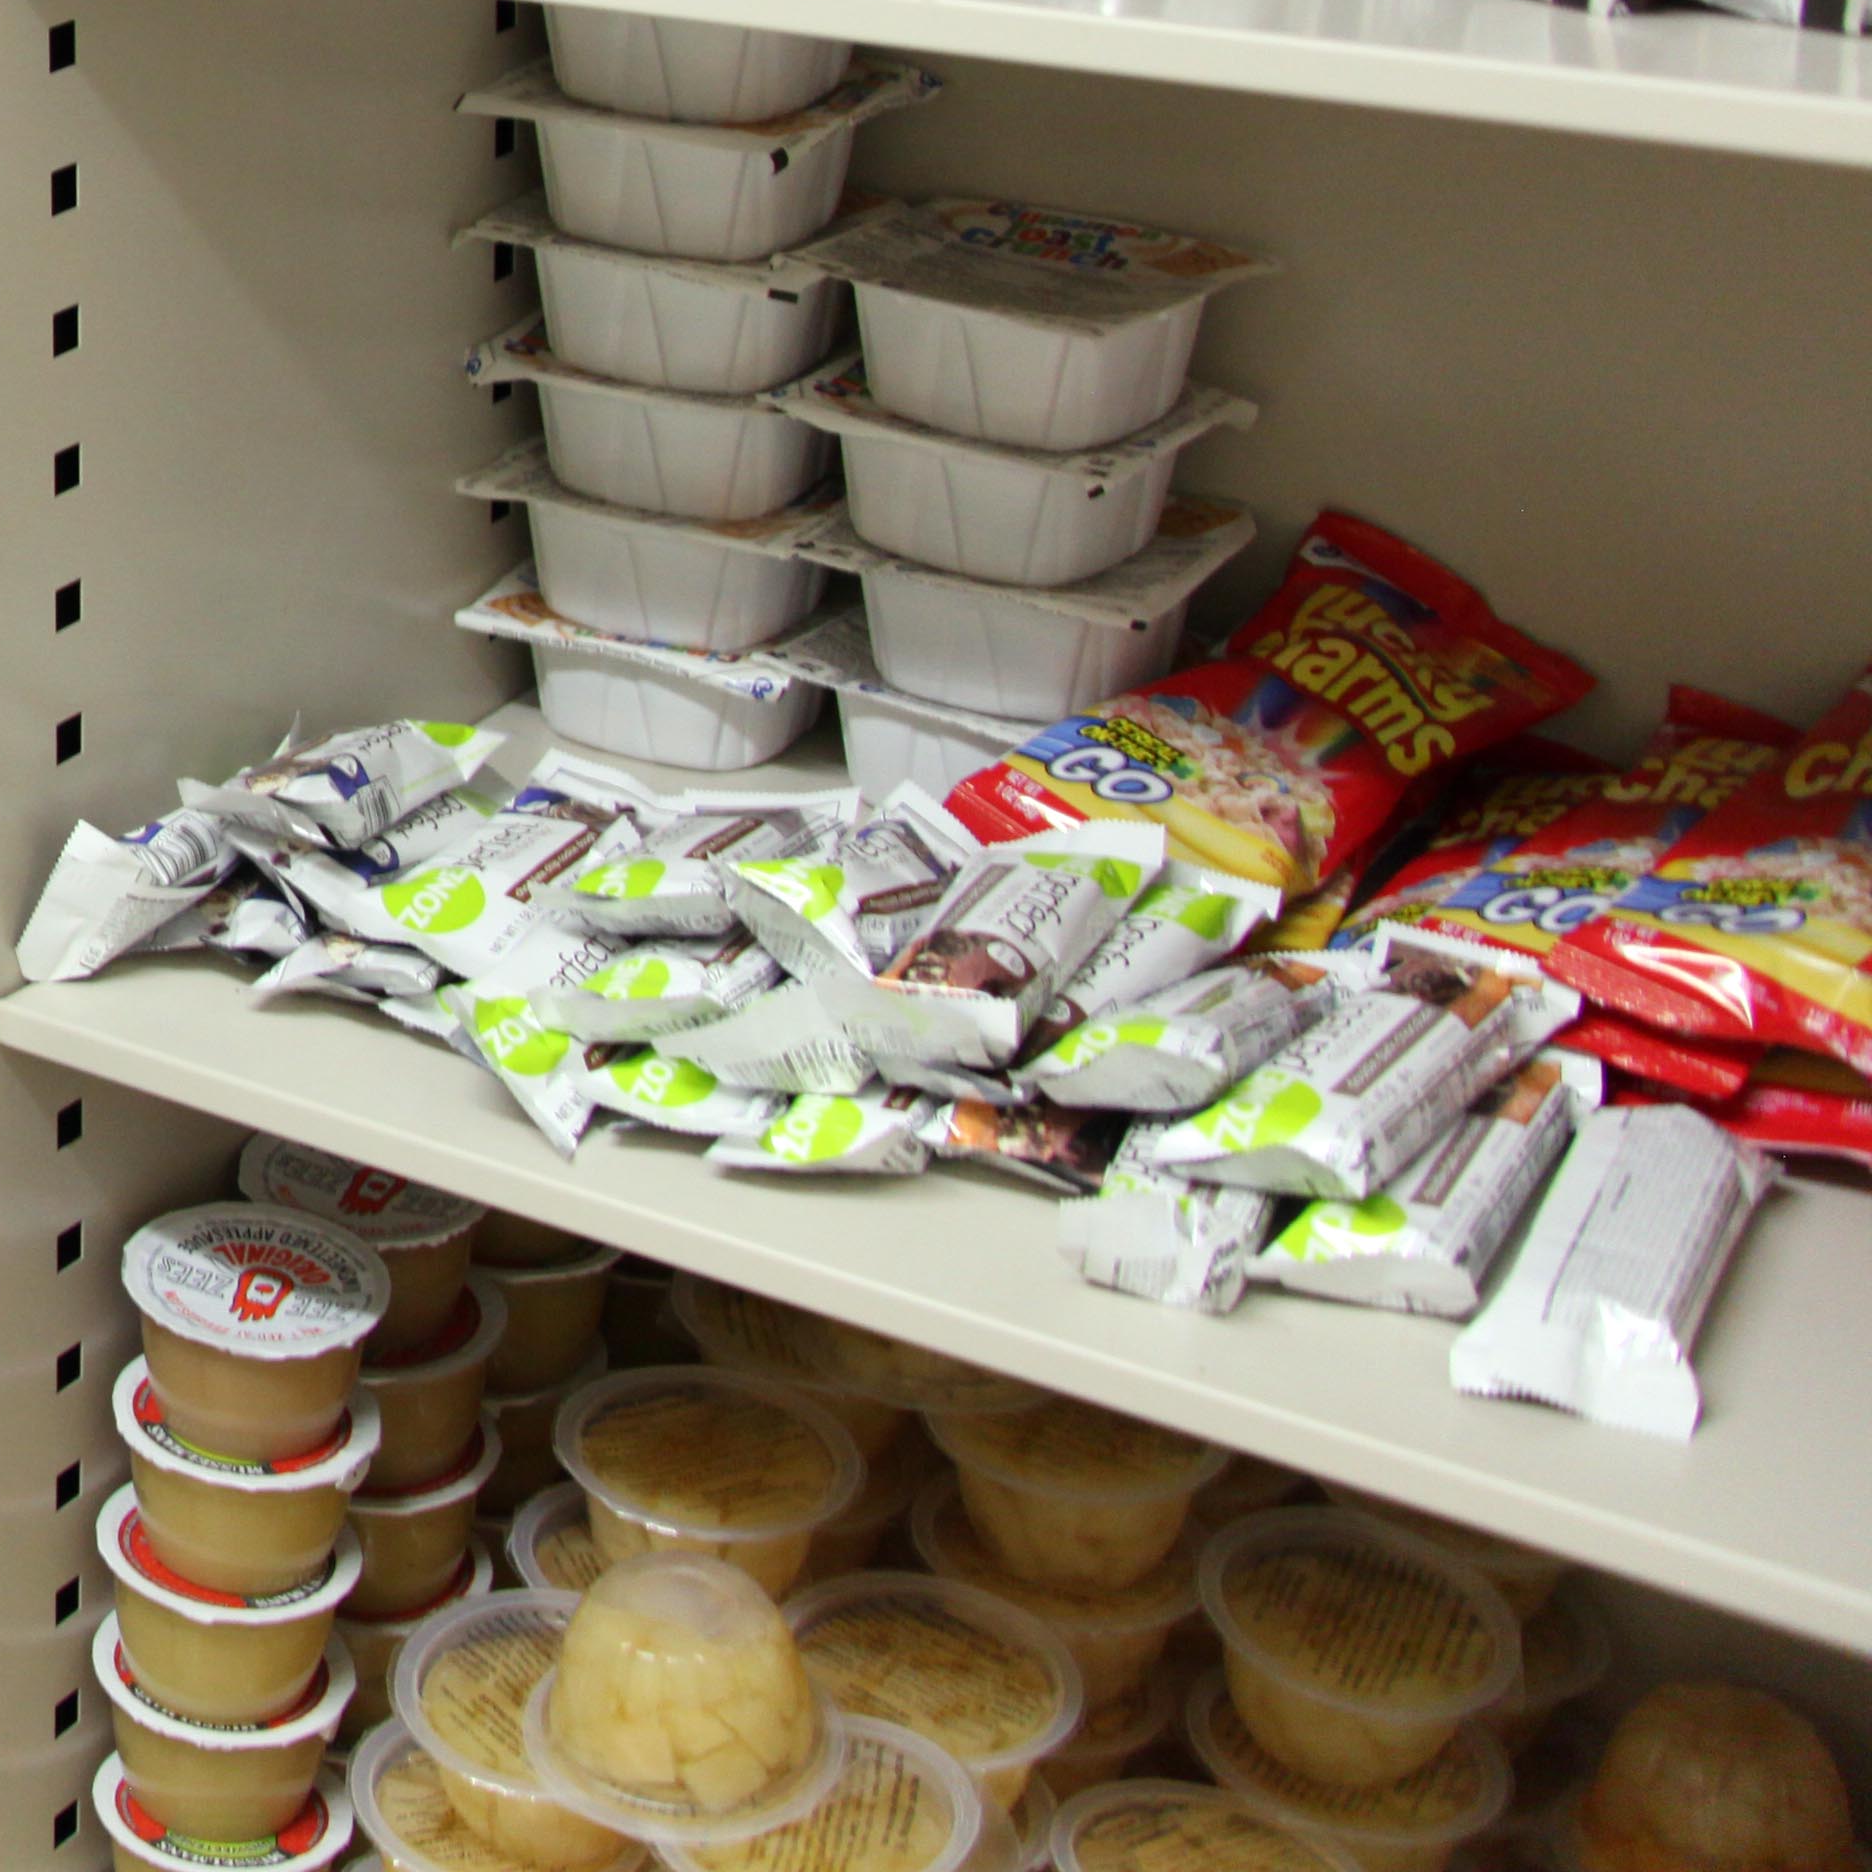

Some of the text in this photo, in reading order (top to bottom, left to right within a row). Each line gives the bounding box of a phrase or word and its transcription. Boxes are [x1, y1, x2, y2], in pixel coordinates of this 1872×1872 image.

[1286, 582, 1497, 725] Lucky
[1045, 745, 1174, 806] GO
[397, 866, 475, 931] ZONE
[1480, 886, 1615, 935] GO
[177, 1226, 275, 1256] APPLESAUCE
[211, 1241, 333, 1286] ORIGINAL
[157, 1254, 235, 1301] ZEES
